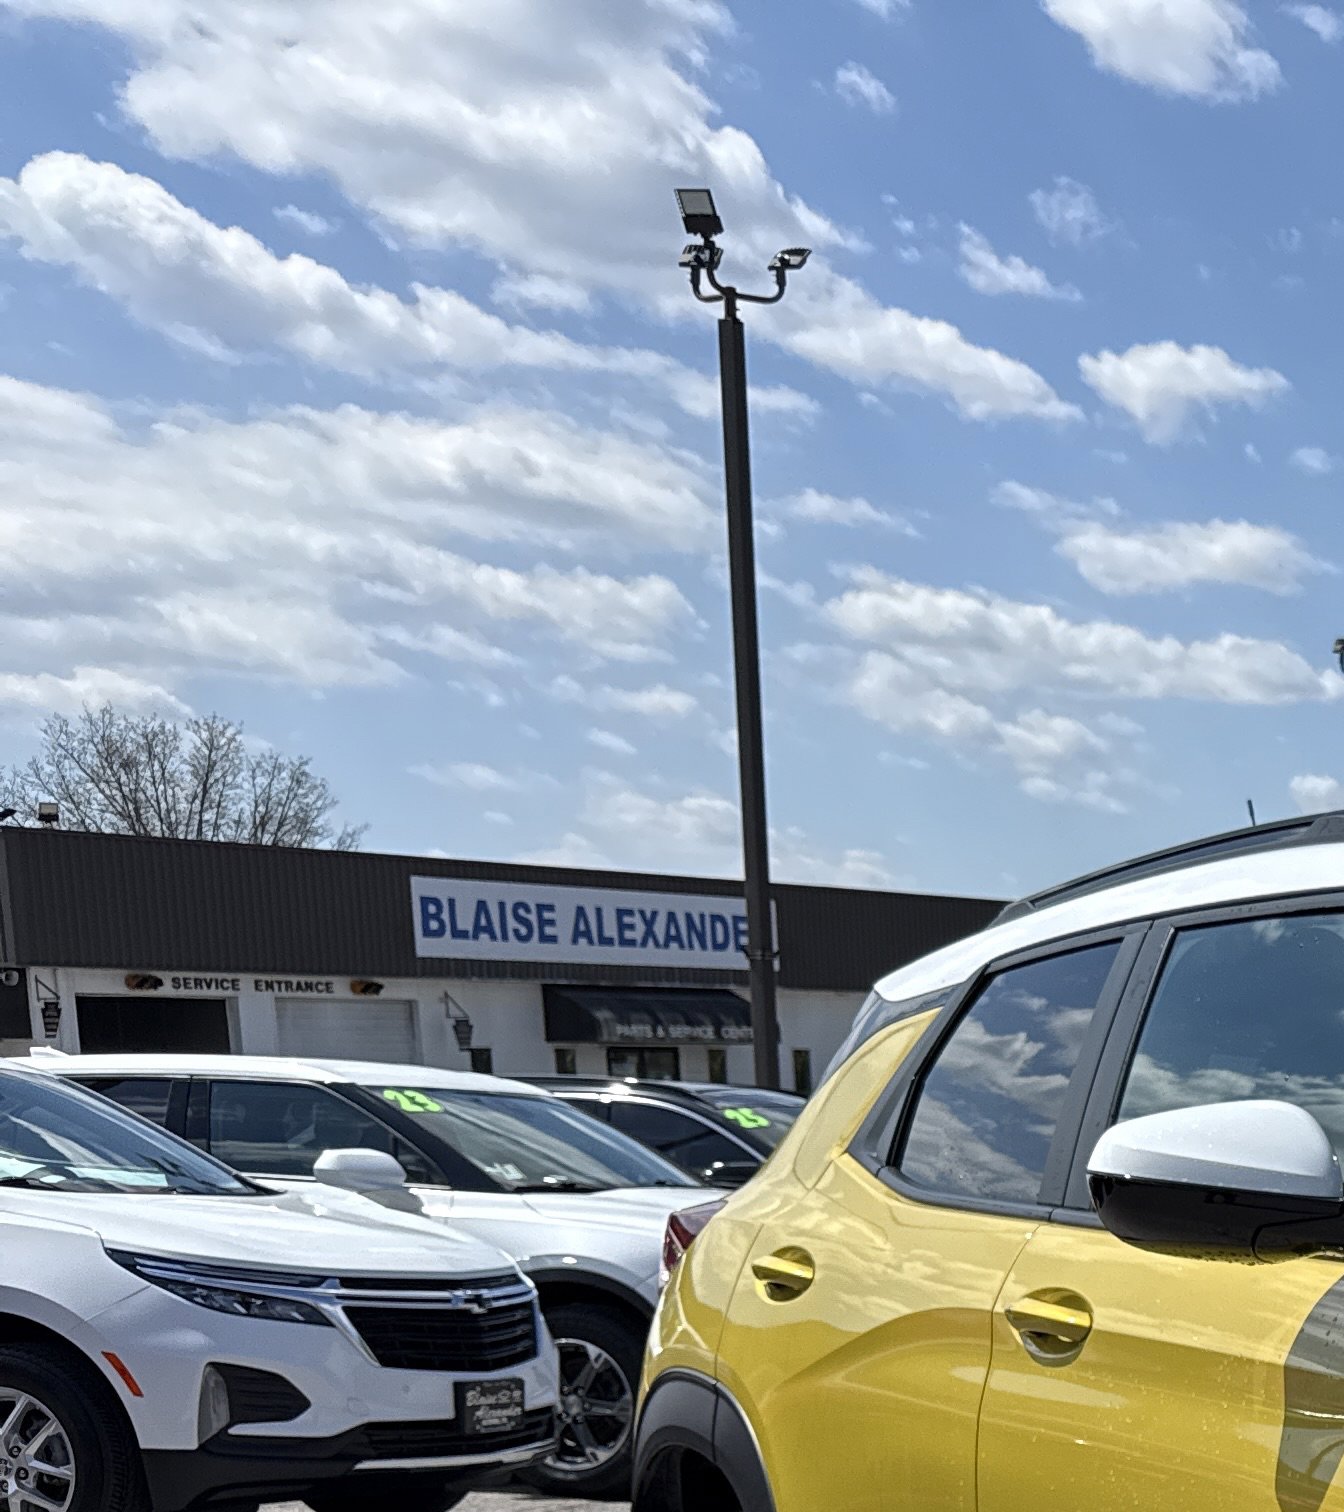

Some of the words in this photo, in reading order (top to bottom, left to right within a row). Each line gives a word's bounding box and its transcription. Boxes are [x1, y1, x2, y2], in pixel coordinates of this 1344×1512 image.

[419, 895, 559, 945] BLAISE
[571, 904, 750, 953] ALEXANDE
[171, 976, 241, 991] SERVICE
[253, 979, 334, 994] ENTRANCE
[381, 1088, 446, 1113] 23
